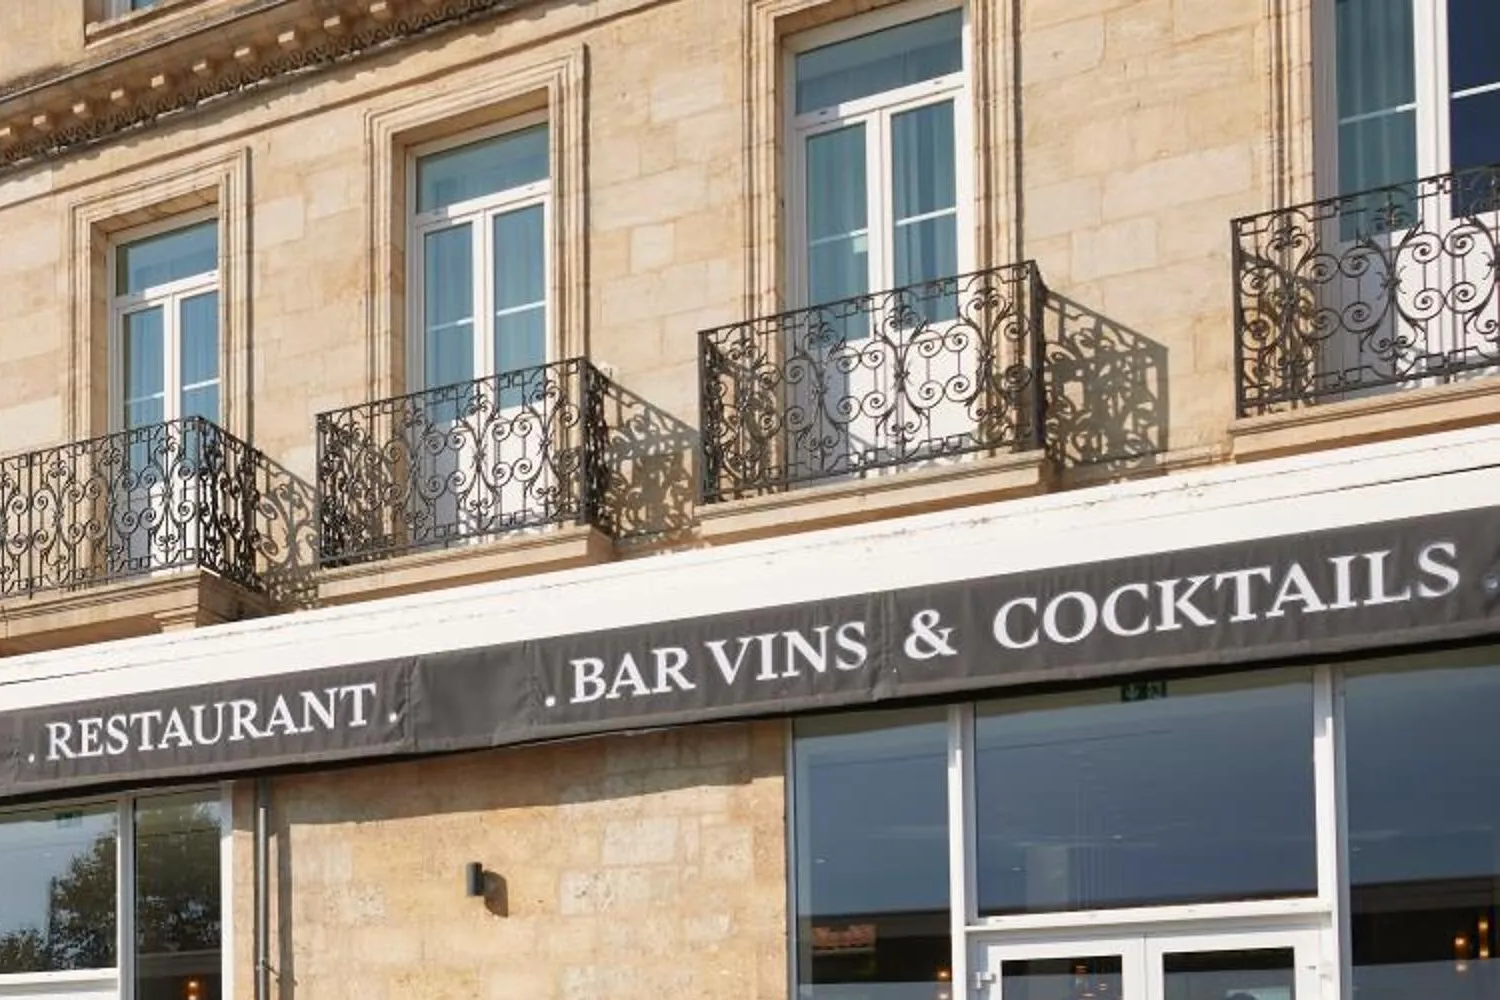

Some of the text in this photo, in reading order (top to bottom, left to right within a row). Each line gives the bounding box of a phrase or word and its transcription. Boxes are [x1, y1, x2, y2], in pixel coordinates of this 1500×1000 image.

[569, 540, 1462, 704] BAR VINS & COCKTAILS
[45, 682, 378, 763] RESTAURANT
